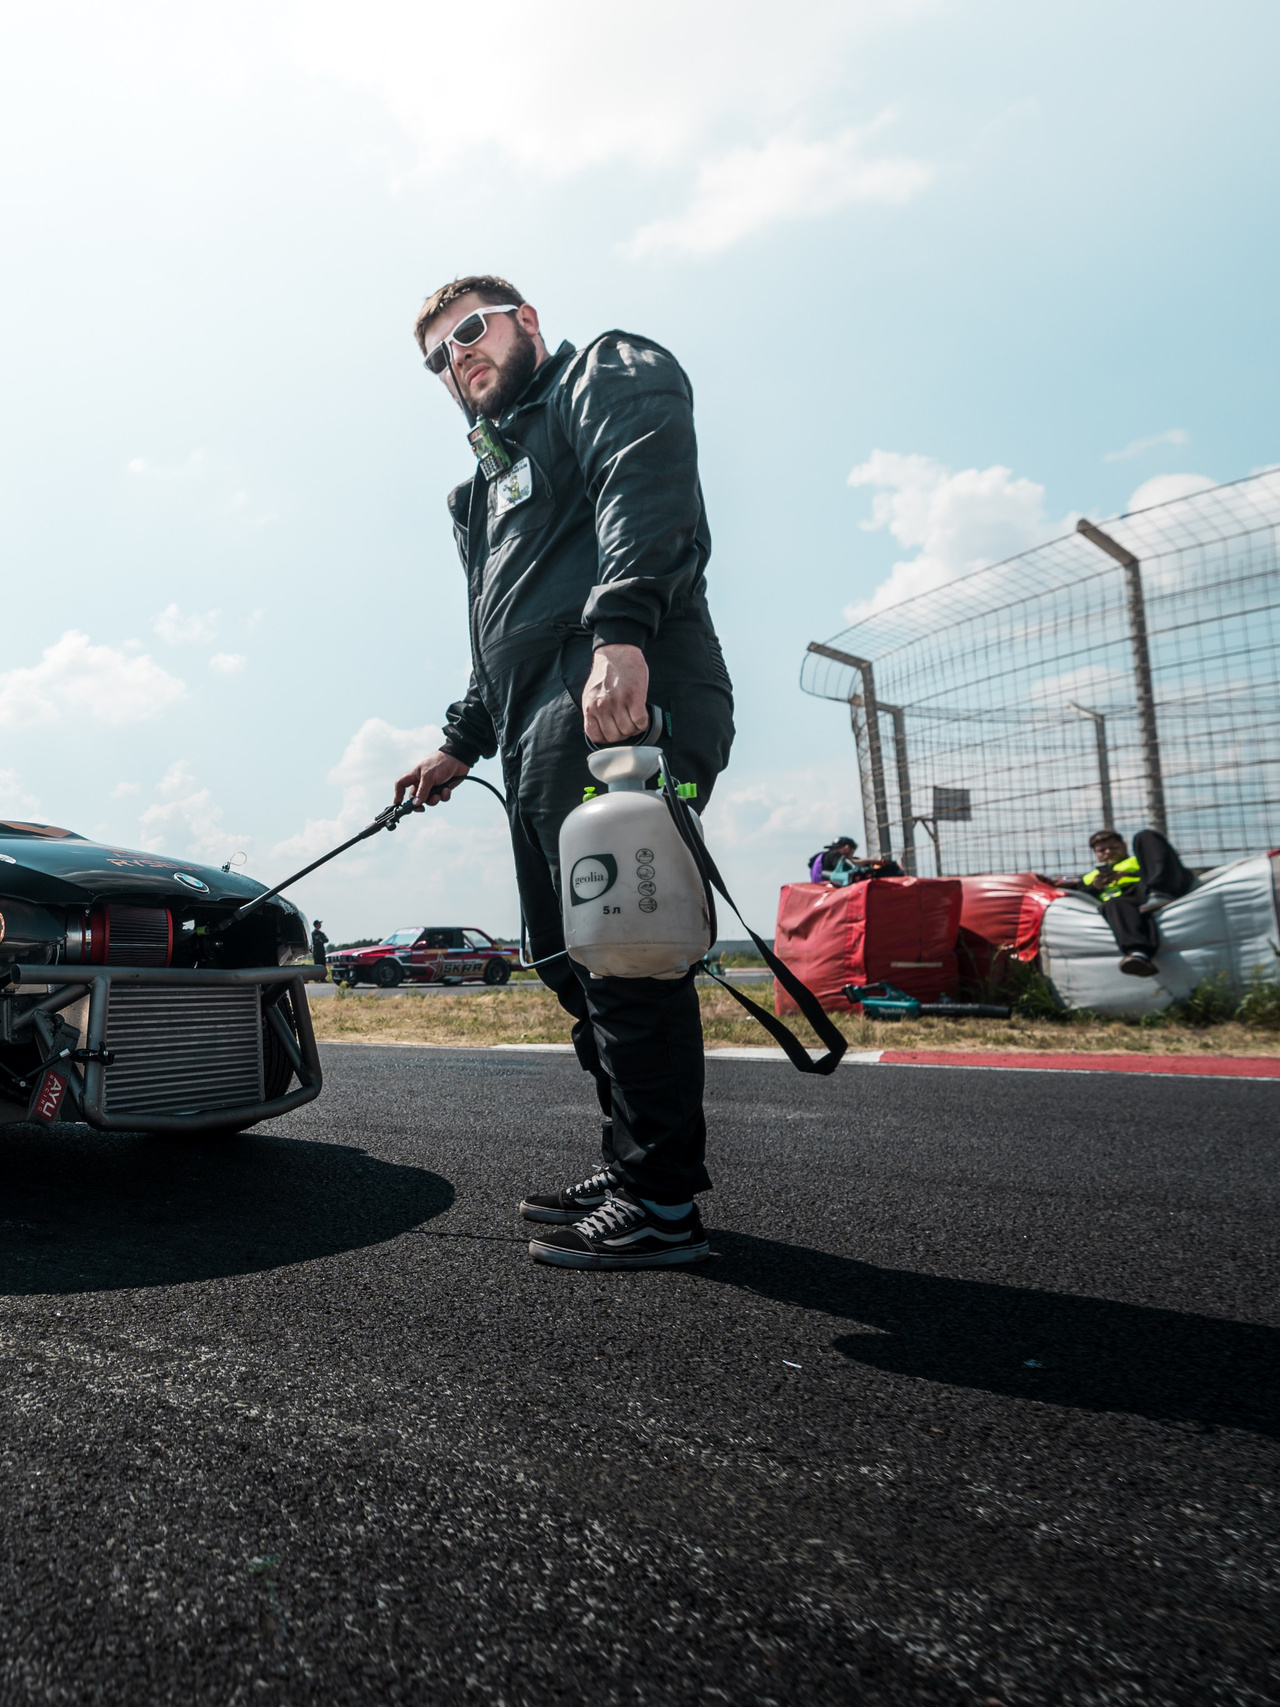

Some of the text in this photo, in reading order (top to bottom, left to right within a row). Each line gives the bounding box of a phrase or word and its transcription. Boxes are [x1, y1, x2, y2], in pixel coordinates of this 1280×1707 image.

[574, 871, 604, 888] geolia
[603, 905, 610, 915] 5
[42, 1077, 62, 1117] AYU
